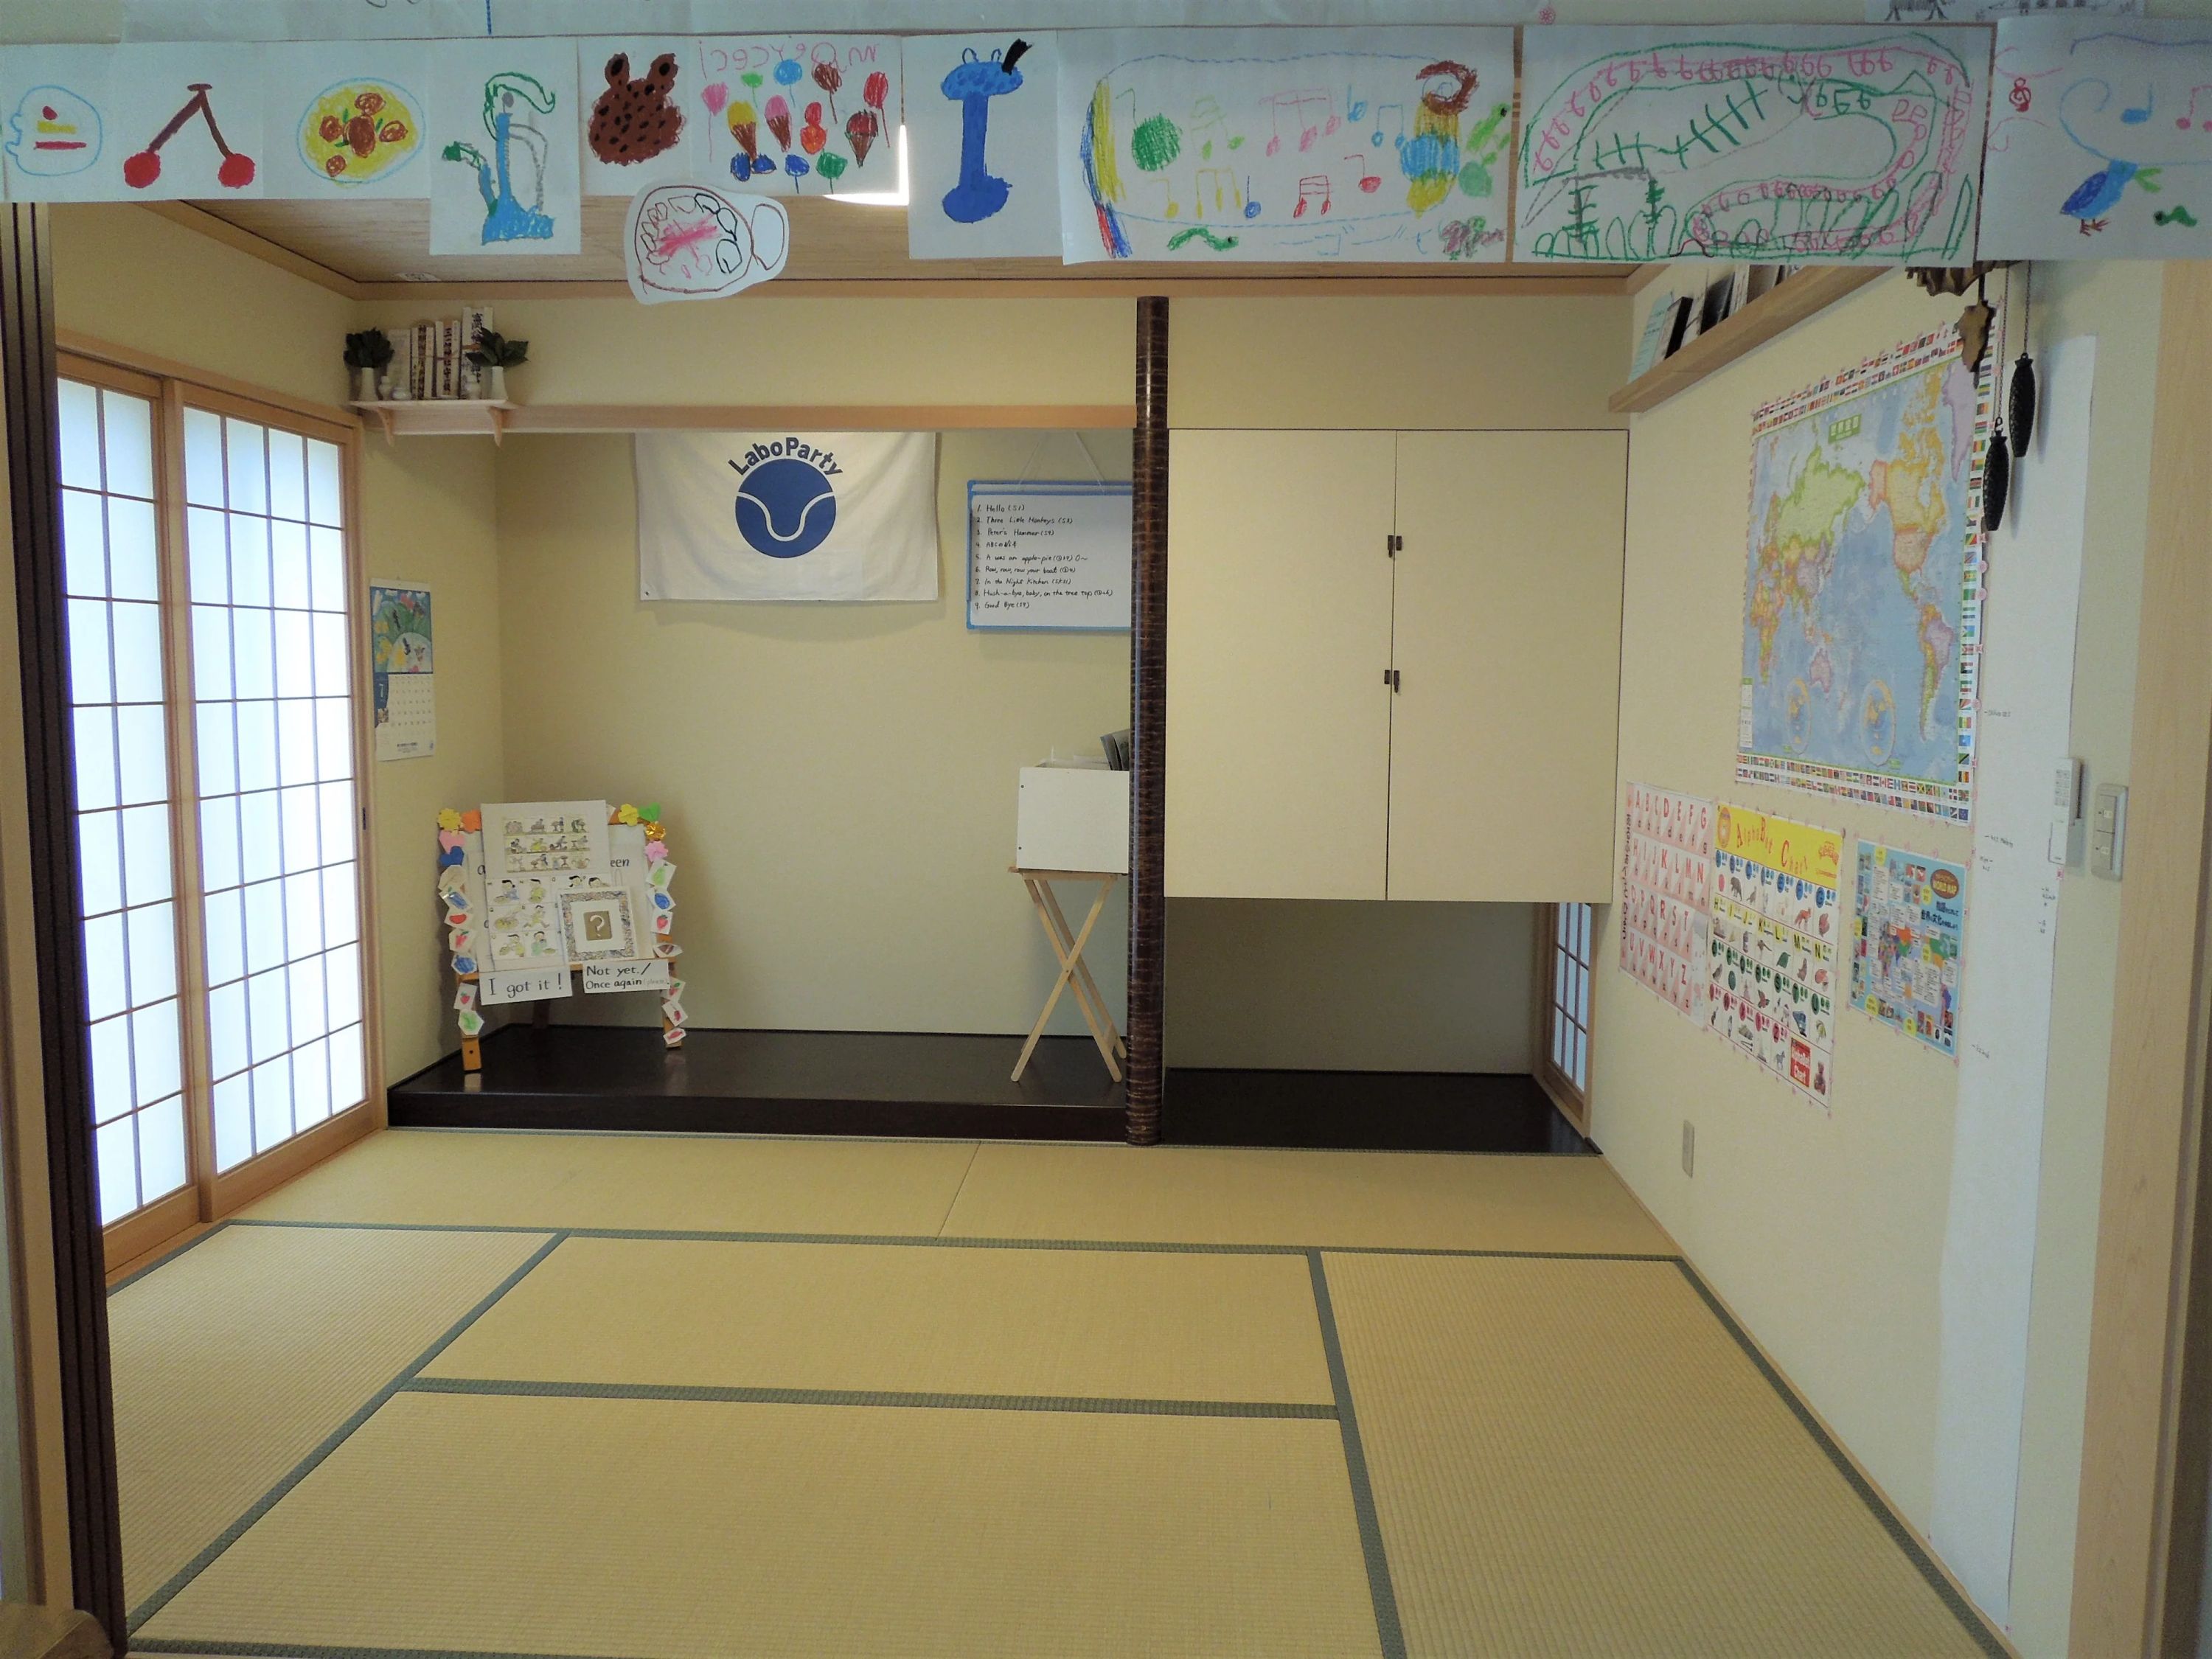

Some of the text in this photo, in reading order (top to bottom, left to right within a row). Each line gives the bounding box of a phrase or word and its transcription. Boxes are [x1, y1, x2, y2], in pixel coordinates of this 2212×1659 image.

[987, 504, 1005, 512] Hello
[1029, 516, 1054, 525] Monkeys
[988, 527, 1007, 536] Peter's
[1006, 577, 1023, 587] Night
[1004, 601, 1015, 610] Bye
[586, 965, 611, 976] Not
[489, 978, 496, 995] I
[507, 981, 531, 998] got
[538, 978, 550, 991] it
[585, 981, 611, 990] Once
[613, 979, 642, 990] again
